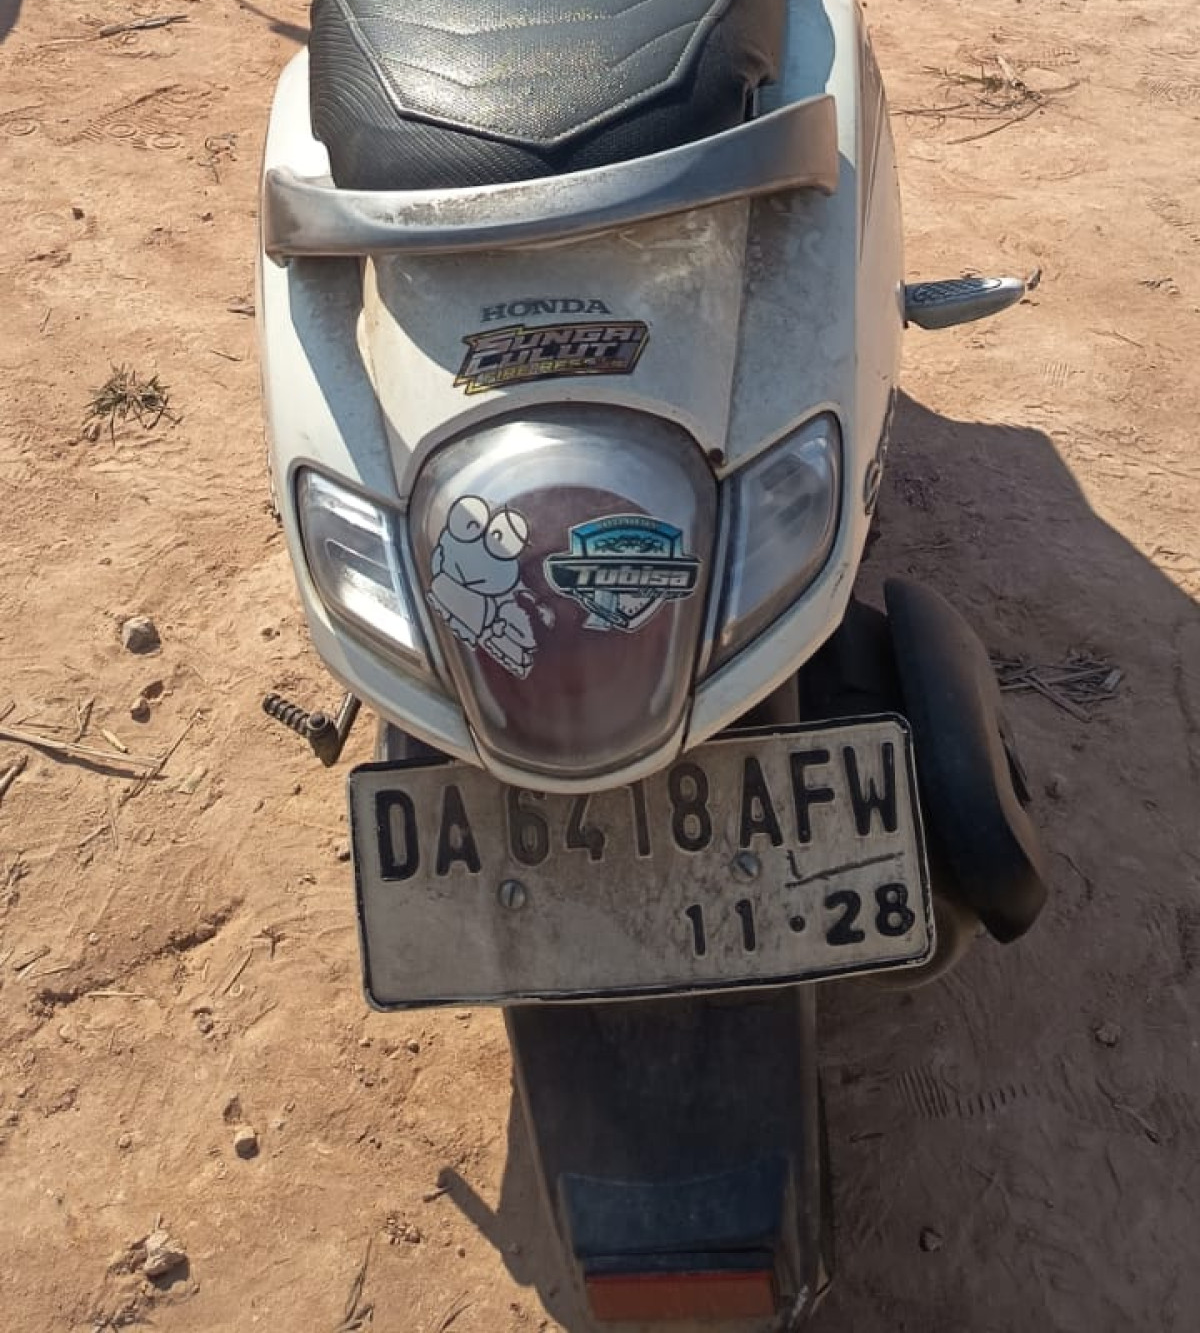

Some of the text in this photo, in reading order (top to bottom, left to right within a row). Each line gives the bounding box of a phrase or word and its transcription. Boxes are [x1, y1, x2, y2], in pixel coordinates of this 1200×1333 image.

[480, 299, 612, 323] HONDA
[566, 564, 690, 587] Tubisa
[374, 742, 899, 882] DA 6418 AFW
